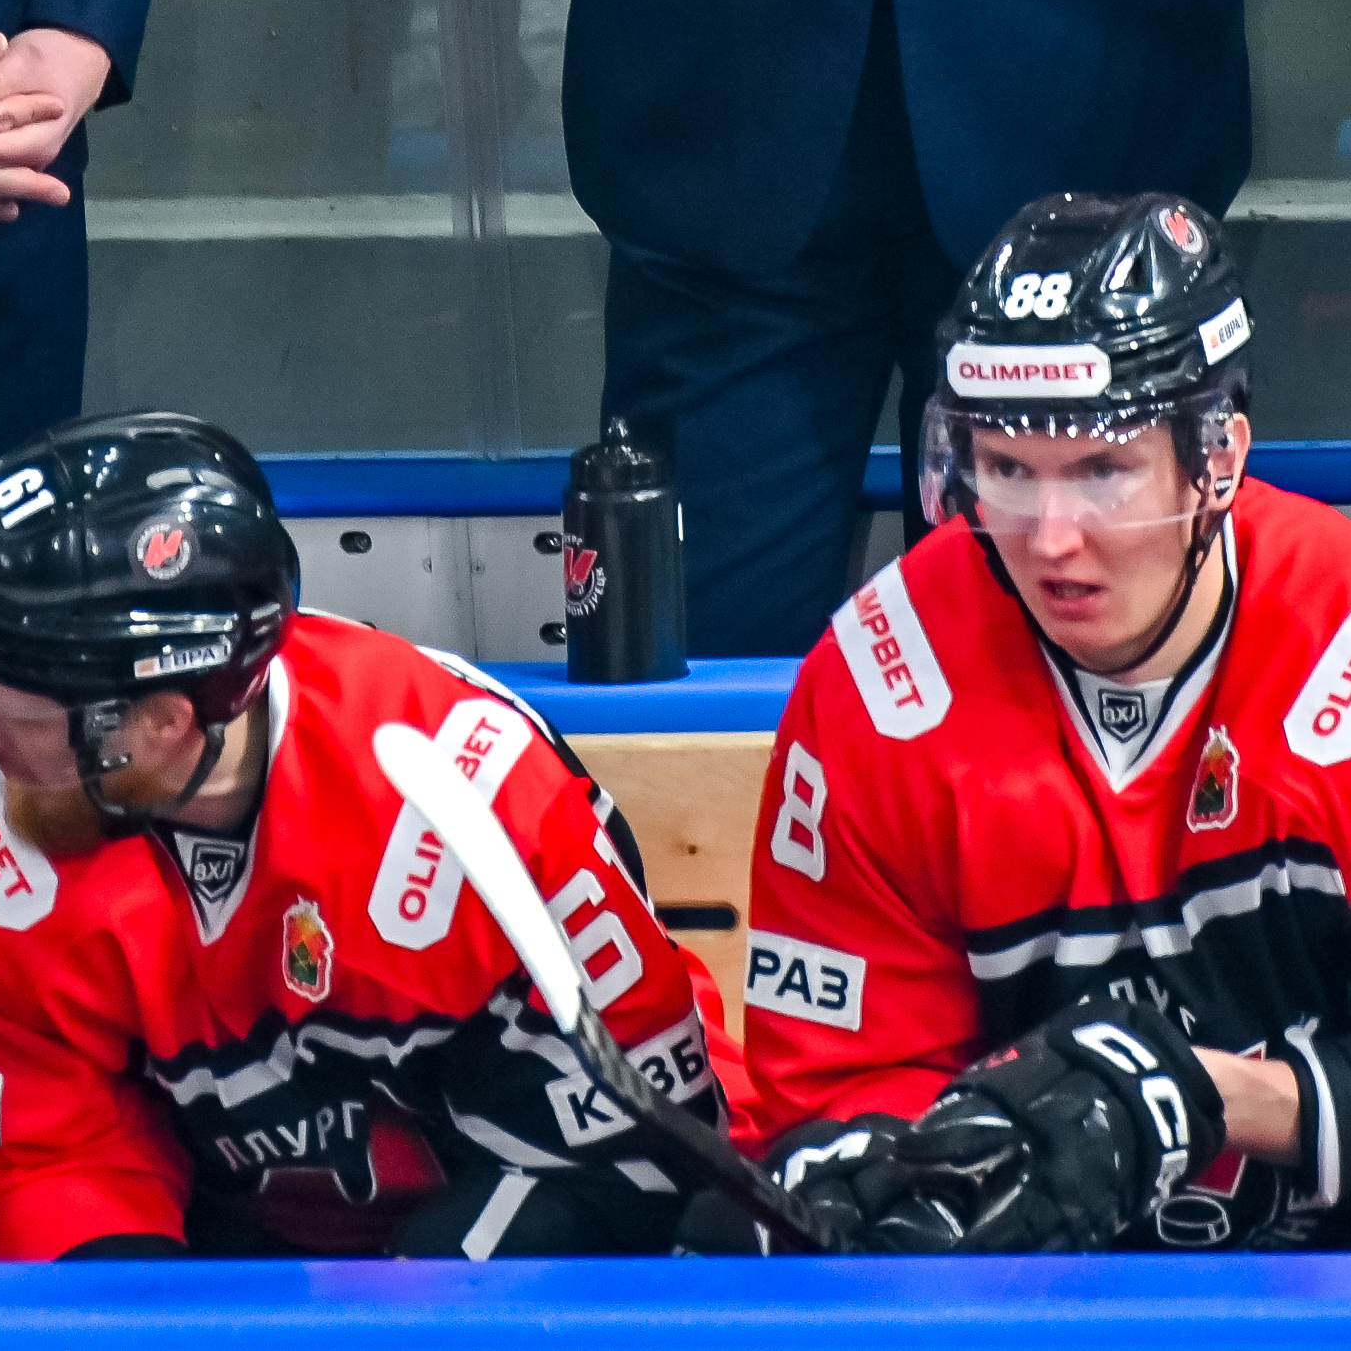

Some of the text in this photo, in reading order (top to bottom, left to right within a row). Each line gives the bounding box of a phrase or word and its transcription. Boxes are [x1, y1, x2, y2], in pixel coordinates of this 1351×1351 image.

[1003, 272, 1072, 320] 88
[958, 360, 1098, 384] OLIMPBET
[398, 715, 502, 923] OLIBET
[770, 741, 828, 883] 8
[748, 952, 848, 1010] РАЗ
[570, 1038, 706, 1132] КЗБ
